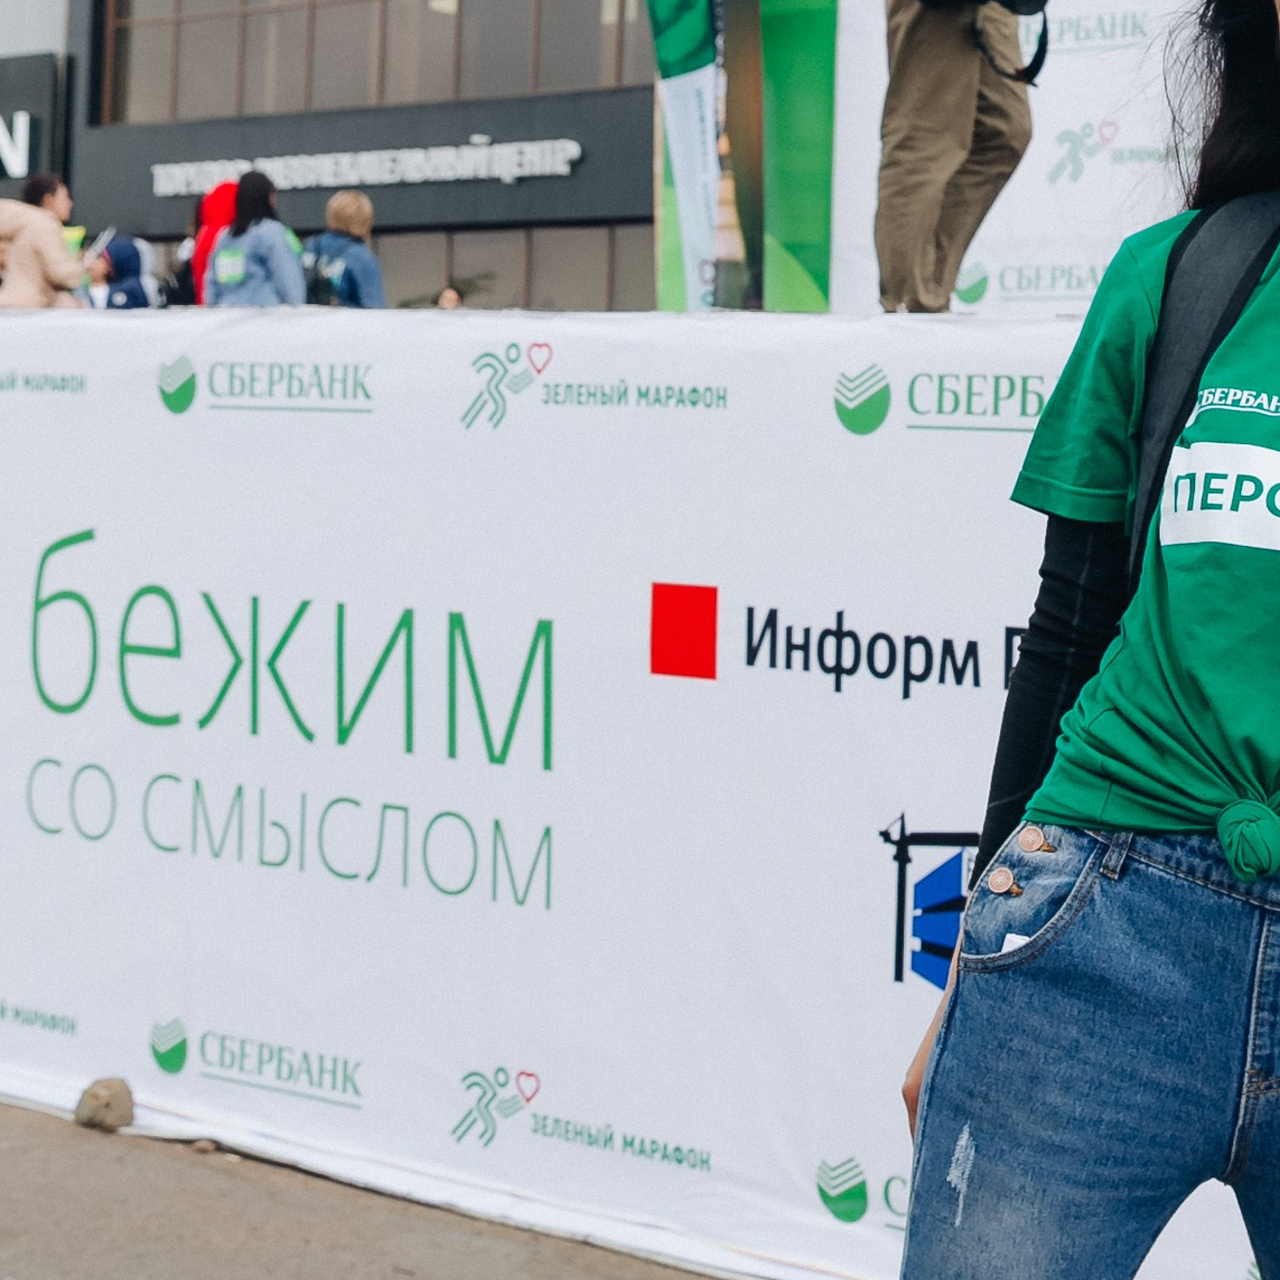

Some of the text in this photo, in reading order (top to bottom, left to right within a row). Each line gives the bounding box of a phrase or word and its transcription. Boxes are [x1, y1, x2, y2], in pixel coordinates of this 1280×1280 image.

[999, 262, 1107, 293] СБЕРБА
[208, 361, 373, 401] СБЕРБАНК
[541, 377, 729, 409] ЗЕЛЕНЫЙ МАРАФОН
[907, 373, 1049, 418] СБЕРБ
[744, 605, 982, 701] Информ
[200, 1030, 363, 1098] СБЕРБАНК
[530, 1113, 712, 1173] ЗЕЛЕНЫЙ МАРАФОН
